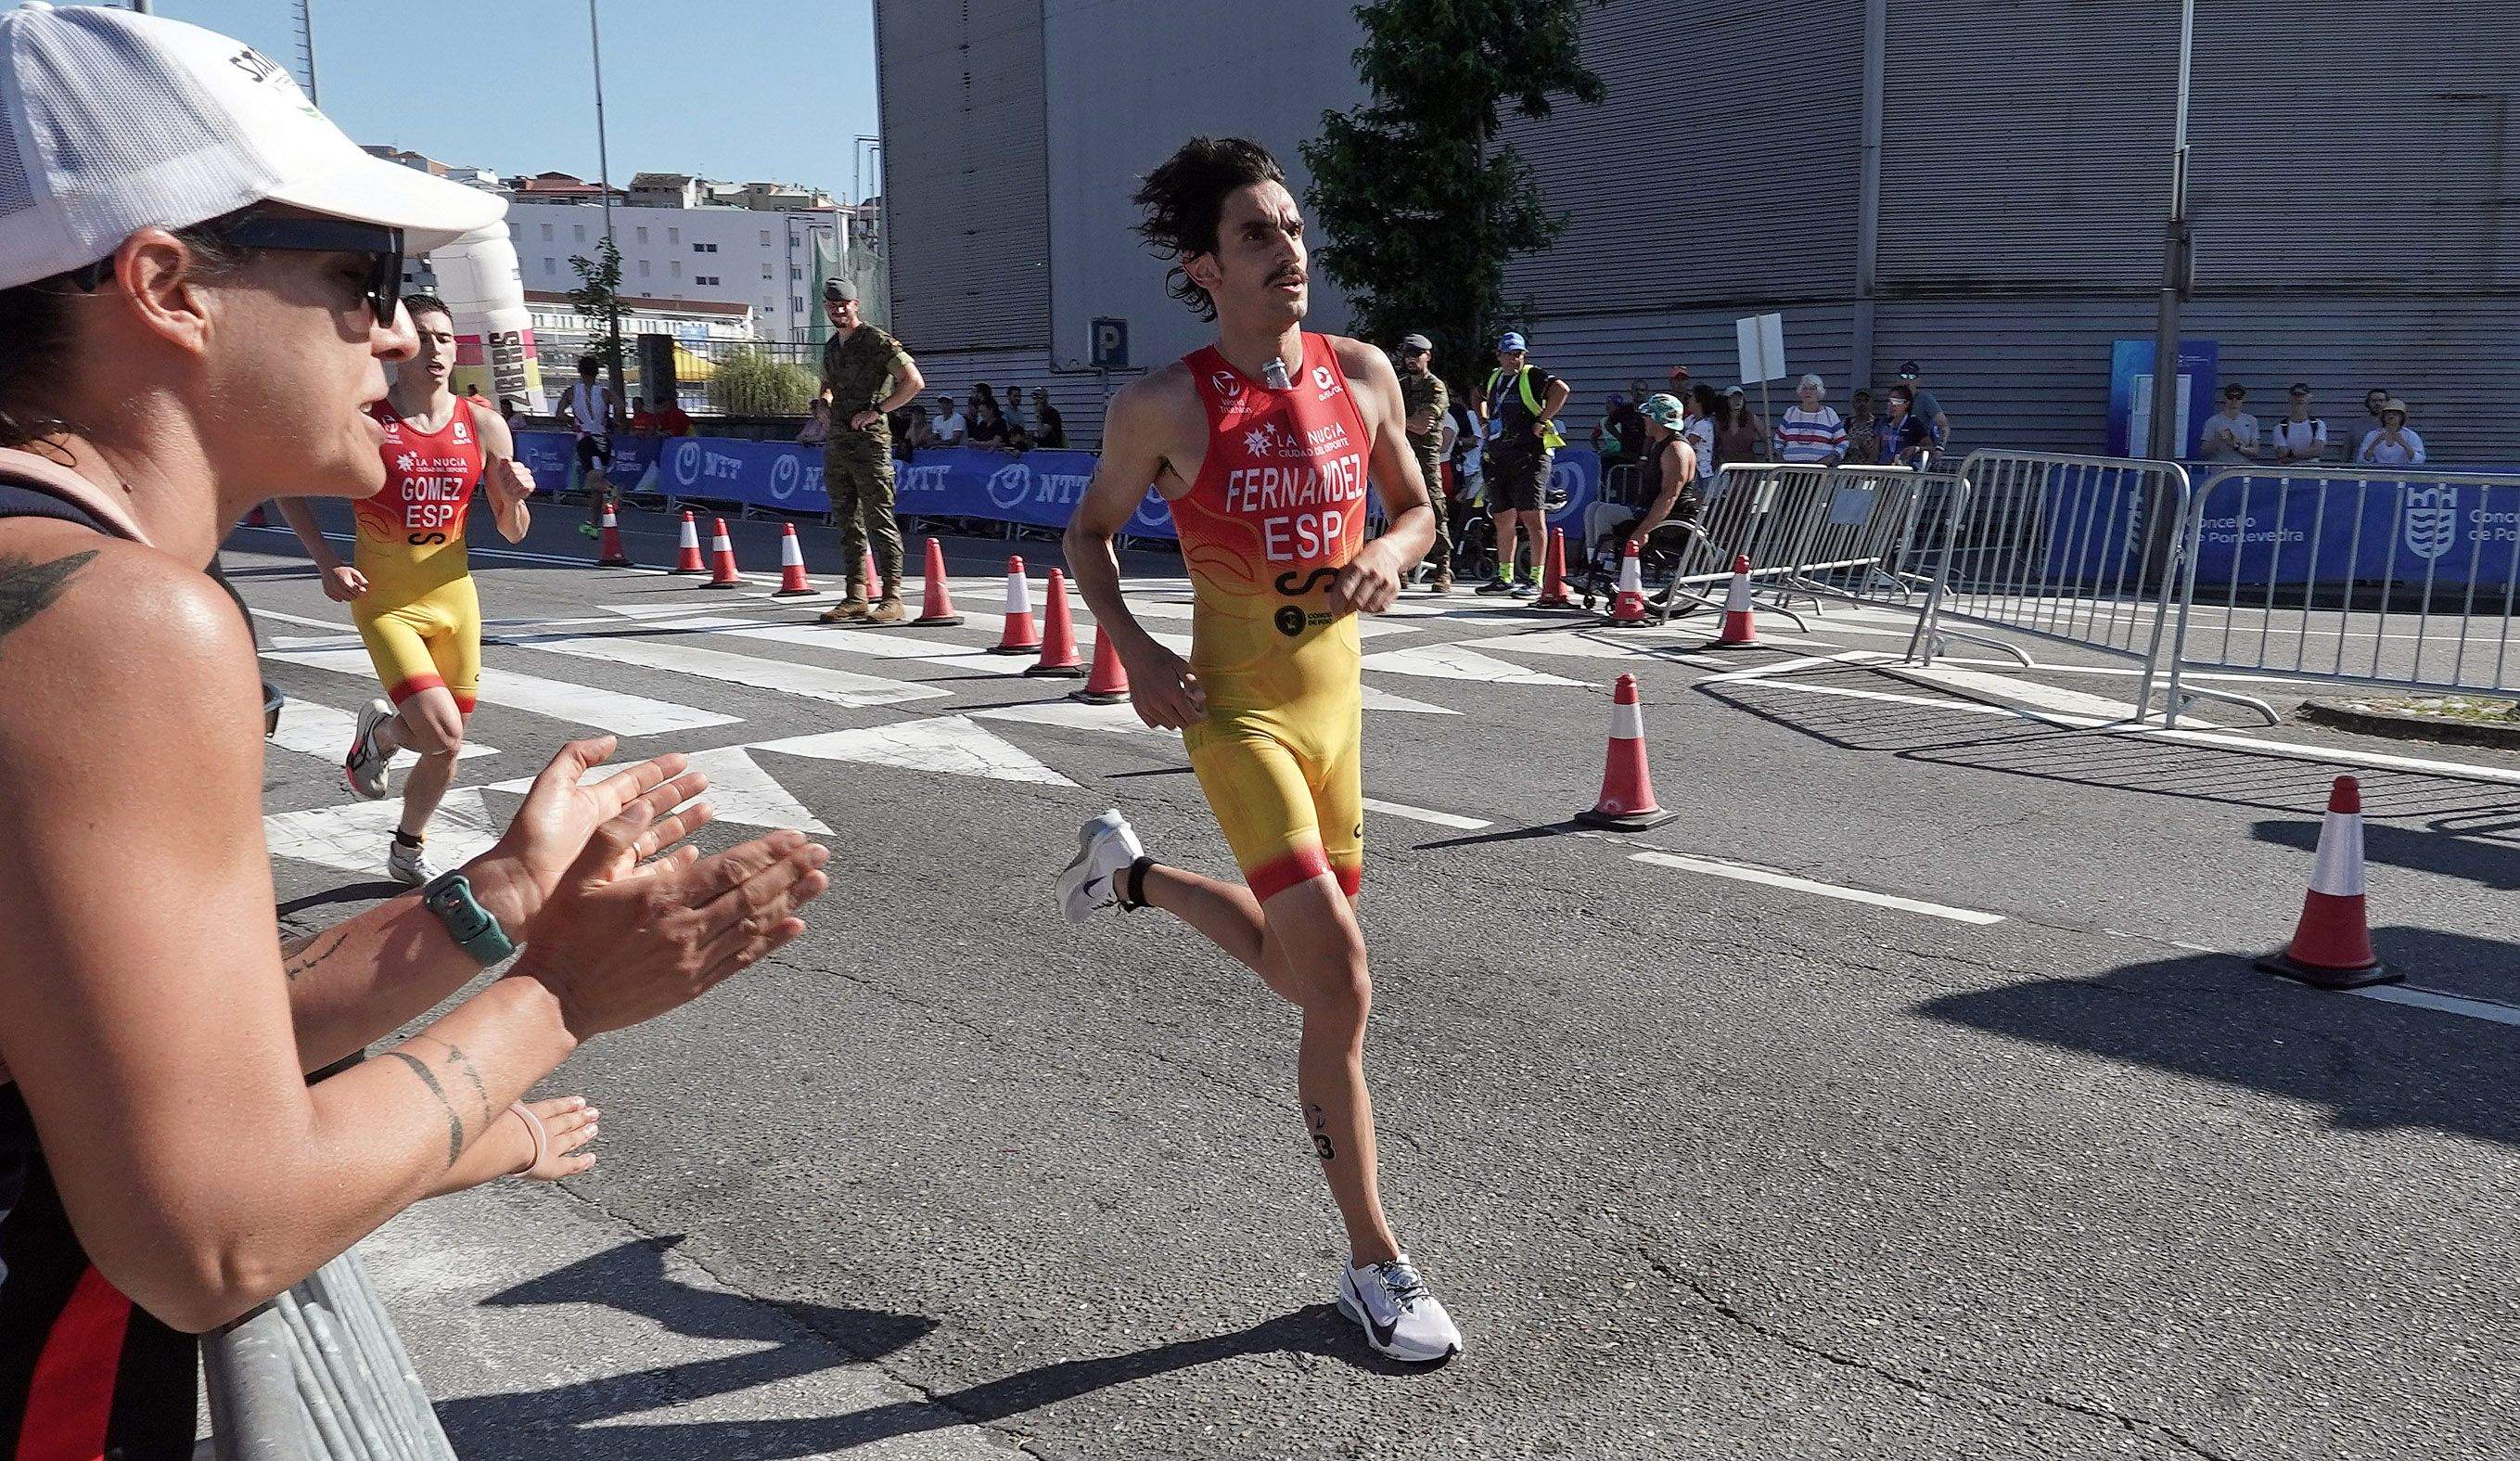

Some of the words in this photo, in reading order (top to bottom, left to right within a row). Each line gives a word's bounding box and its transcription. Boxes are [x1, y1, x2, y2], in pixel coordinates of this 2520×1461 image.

[1099, 325, 1119, 361] P
[1277, 433, 1298, 448] LA
[704, 451, 742, 481] NTT
[902, 464, 953, 492] NTT
[402, 476, 464, 502] GOMEZ
[1035, 473, 1092, 505] NTT
[1226, 454, 1363, 513] FERNANDEZ
[405, 504, 454, 529] ESP
[1263, 510, 1343, 561] ESP
[1313, 1133, 1337, 1160] 3
